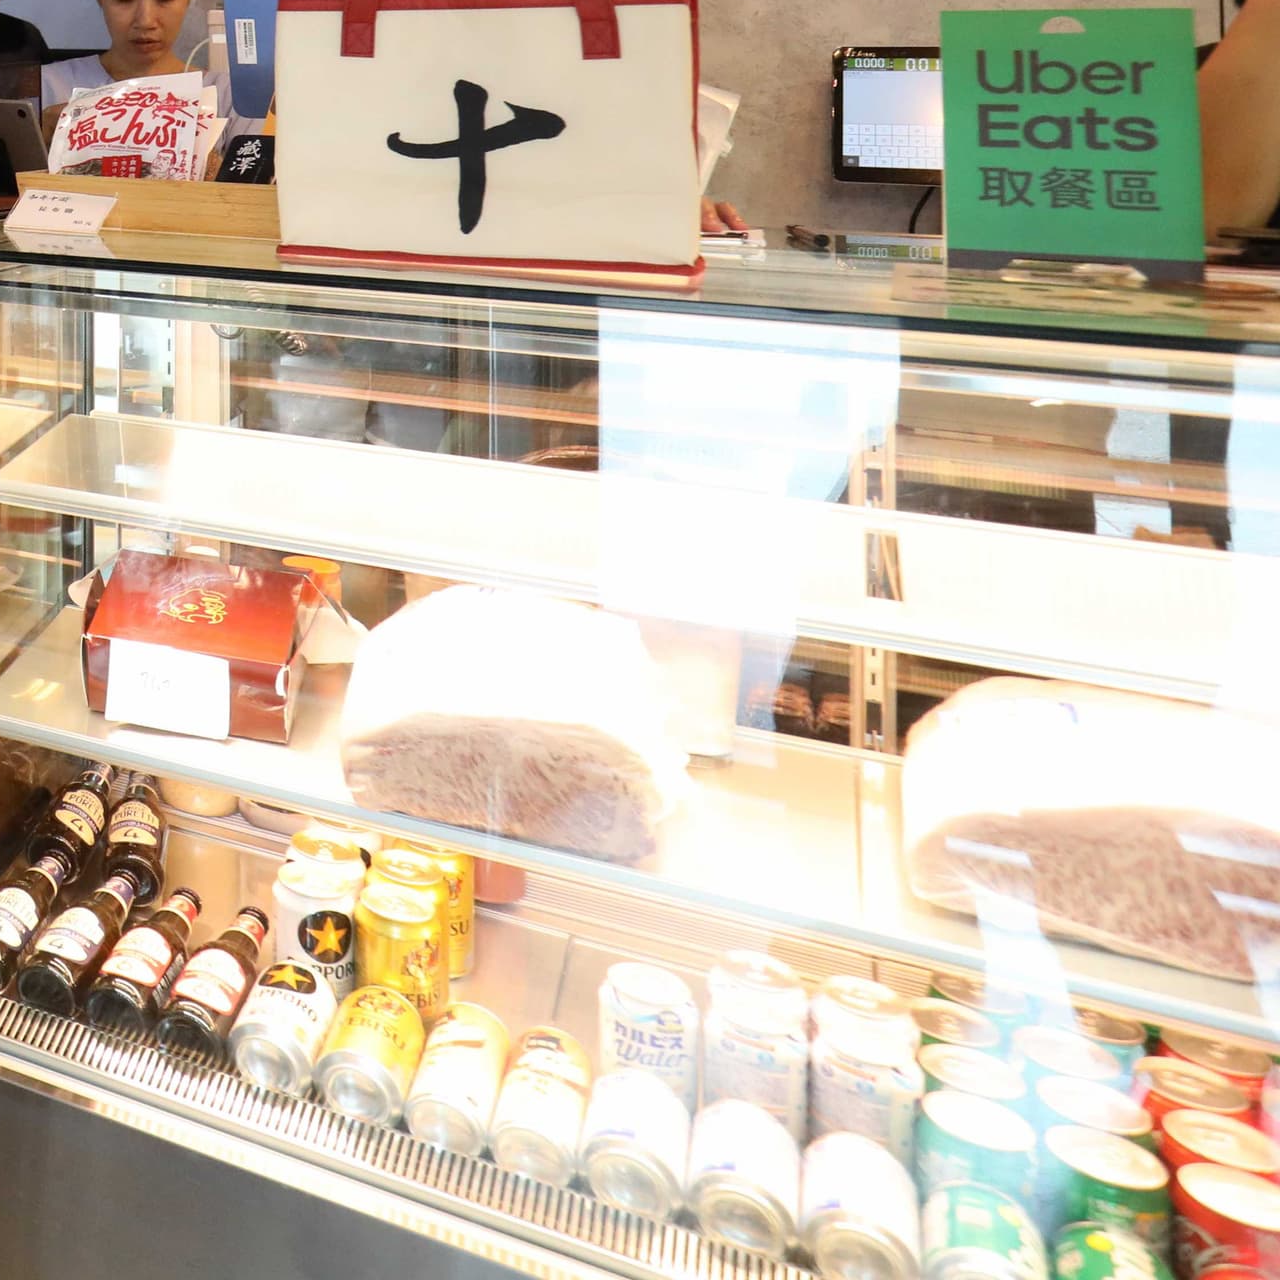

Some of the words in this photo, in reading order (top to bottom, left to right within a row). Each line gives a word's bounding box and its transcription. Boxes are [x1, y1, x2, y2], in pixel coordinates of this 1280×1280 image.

[976, 49, 1155, 95] Uber
[977, 103, 1159, 152] Eats
[387, 79, 567, 234] 十
[978, 166, 1163, 212] 取餐區
[613, 1019, 685, 1050] カルピス
[614, 1038, 689, 1068] Water
